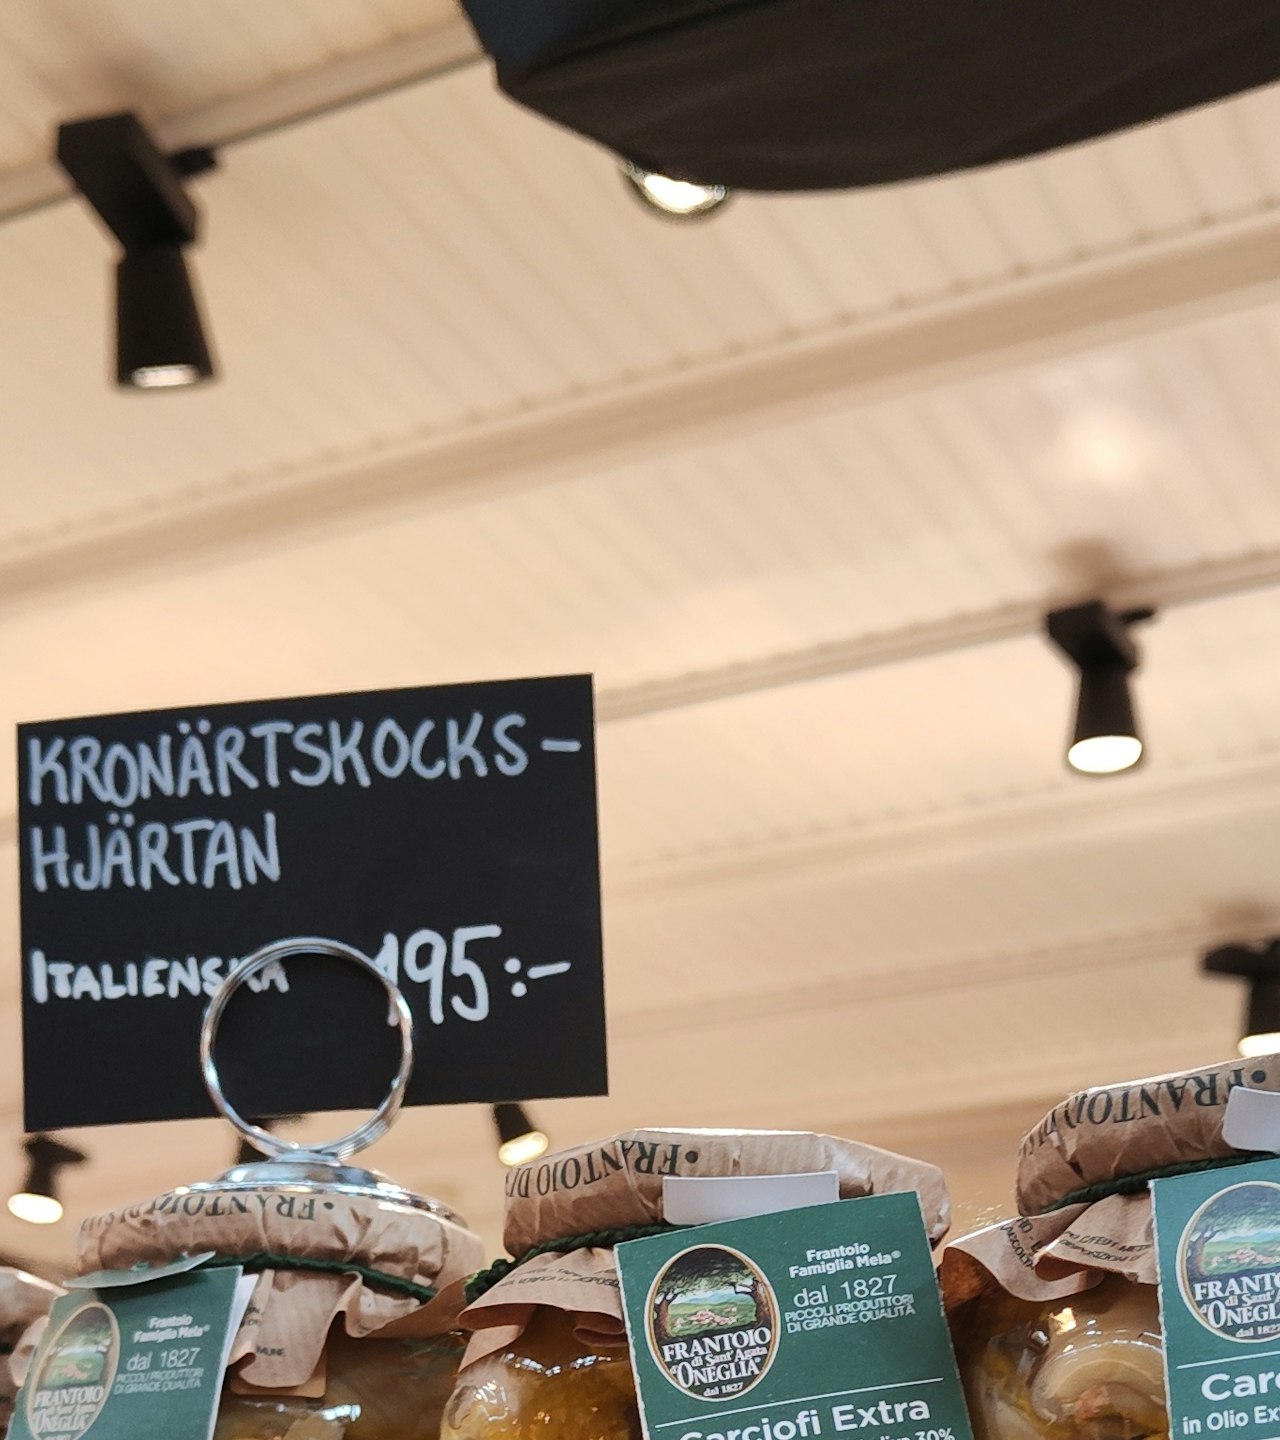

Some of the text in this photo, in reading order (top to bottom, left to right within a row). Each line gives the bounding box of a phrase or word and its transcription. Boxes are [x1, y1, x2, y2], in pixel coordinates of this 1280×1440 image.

[29, 811, 281, 893] HJÄRTAN
[805, 1242, 870, 1262] Frantoio
[788, 1257, 854, 1278] Famiglia
[793, 1273, 897, 1307] dal 1827
[783, 1293, 914, 1322] PICCOLI PRODUTTORI
[786, 1321, 801, 1333] DI
[801, 1311, 858, 1331] GRANDE
[661, 1326, 771, 1362] FRANTOIO
[690, 1355, 703, 1367] di
[831, 1399, 930, 1431] Extra
[1182, 1415, 1201, 1435] in
[1206, 1409, 1249, 1430] Olio
